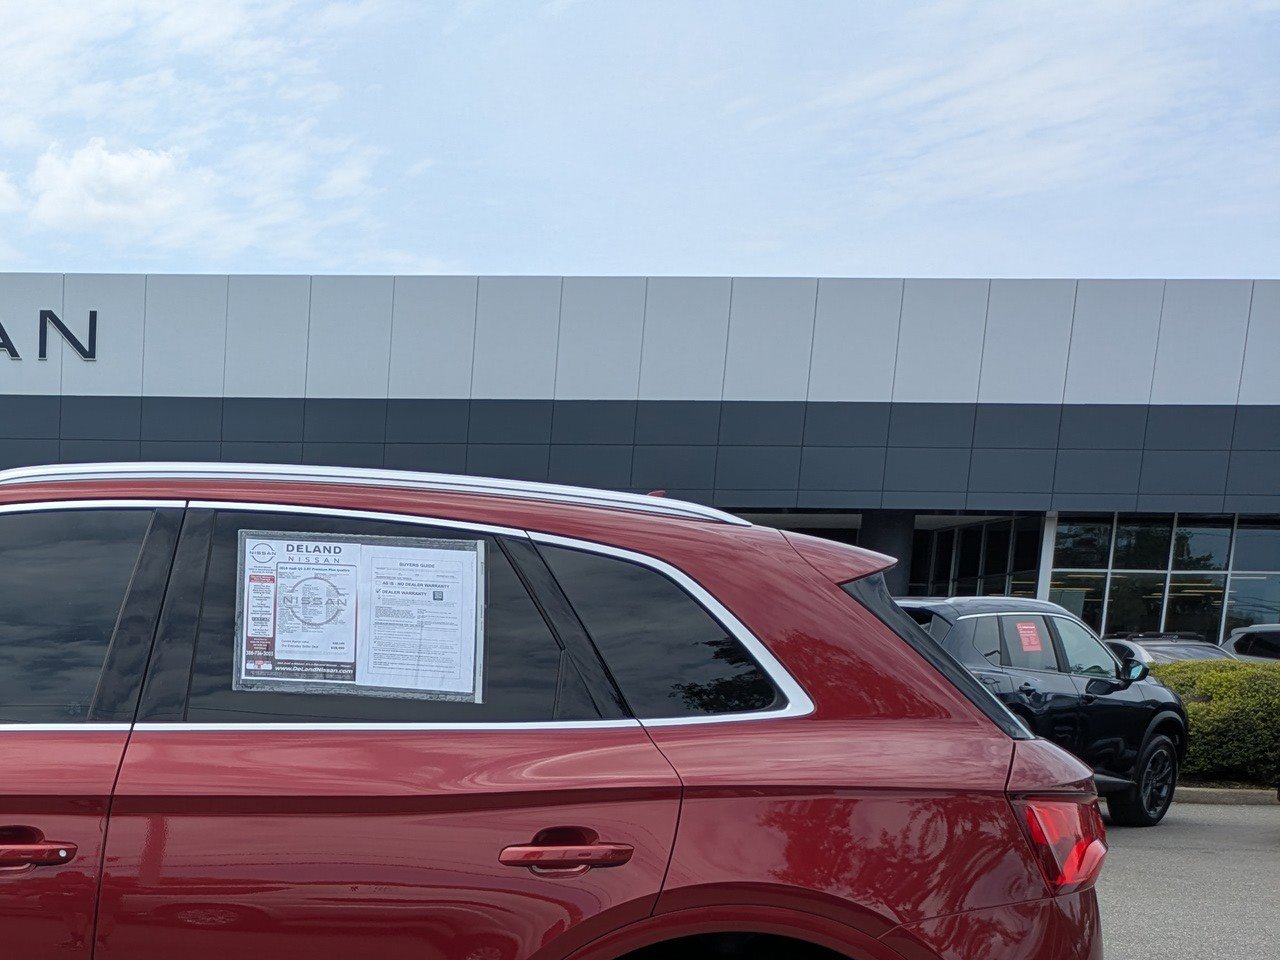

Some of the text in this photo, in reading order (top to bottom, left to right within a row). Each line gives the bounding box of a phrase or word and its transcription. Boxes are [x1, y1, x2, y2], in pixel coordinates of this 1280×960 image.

[286, 544, 342, 555] DELAND
[288, 556, 340, 564] NISSAN
[283, 595, 348, 606] NISSAN
[275, 665, 354, 675] www.DeLandNissan.com
